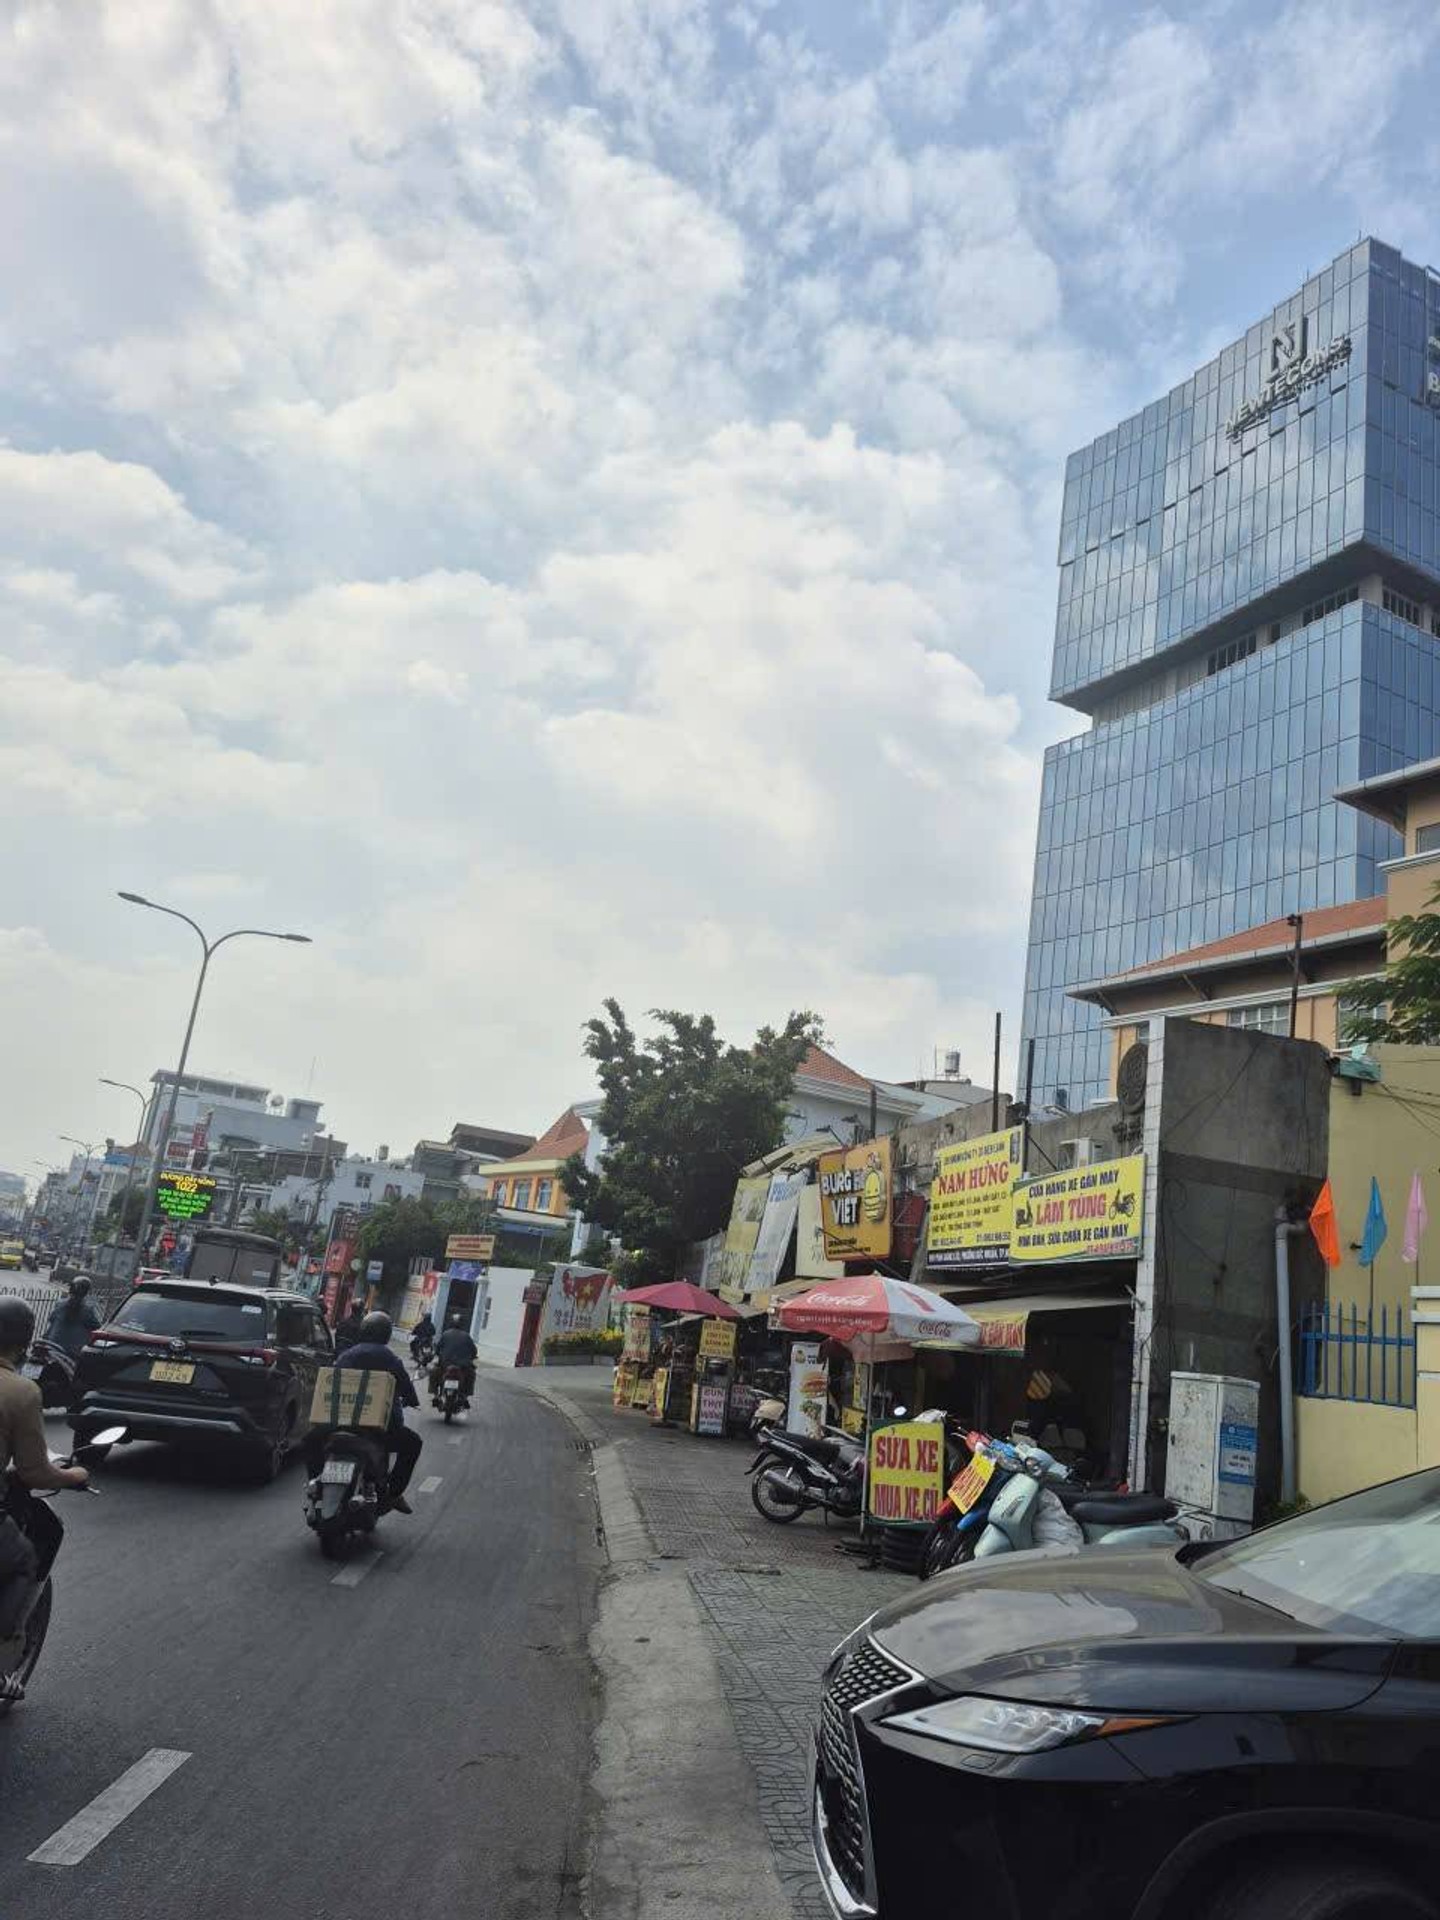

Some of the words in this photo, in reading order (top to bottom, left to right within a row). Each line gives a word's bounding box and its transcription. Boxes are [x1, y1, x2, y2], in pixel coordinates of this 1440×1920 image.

[1225, 333, 1352, 436] NEWTECONS
[175, 1181, 198, 1193] 1022
[938, 1171, 966, 1196] NAM
[915, 1438, 938, 1473] XE
[874, 1484, 901, 1518] MUA
[904, 1486, 920, 1520] XE
